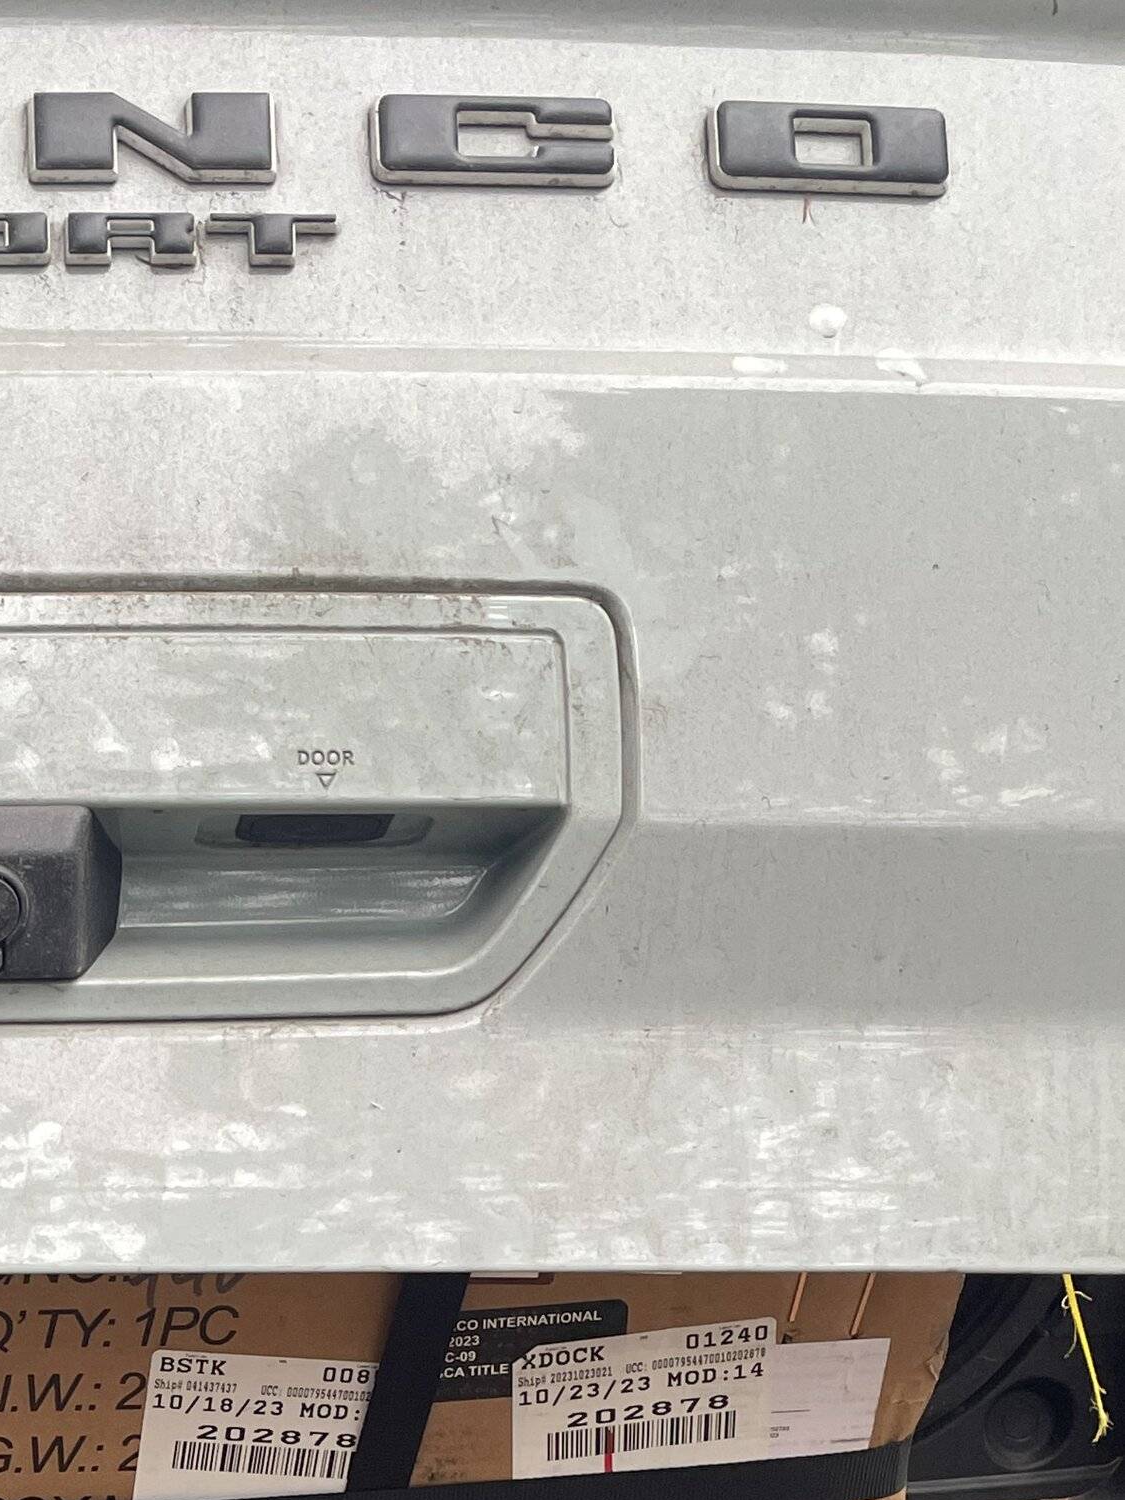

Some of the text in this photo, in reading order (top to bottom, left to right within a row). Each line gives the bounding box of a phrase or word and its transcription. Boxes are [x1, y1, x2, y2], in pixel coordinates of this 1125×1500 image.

[296, 750, 355, 766] DOOR
[135, 1305, 239, 1347] 1PC
[452, 1310, 602, 1333] CO INTERNATIONAL
[449, 1335, 480, 1347] 2023
[686, 1325, 769, 1349] 01240
[159, 1357, 227, 1376] BSTK
[521, 1345, 606, 1370] XDOCK
[440, 1363, 509, 1380] CA TITLE
[518, 1361, 765, 1407] 10/23/23 MOD:14
[152, 1393, 361, 1422] 10/18/23 MOD:
[566, 1394, 730, 1428] 202878
[196, 1424, 358, 1449] 202878
